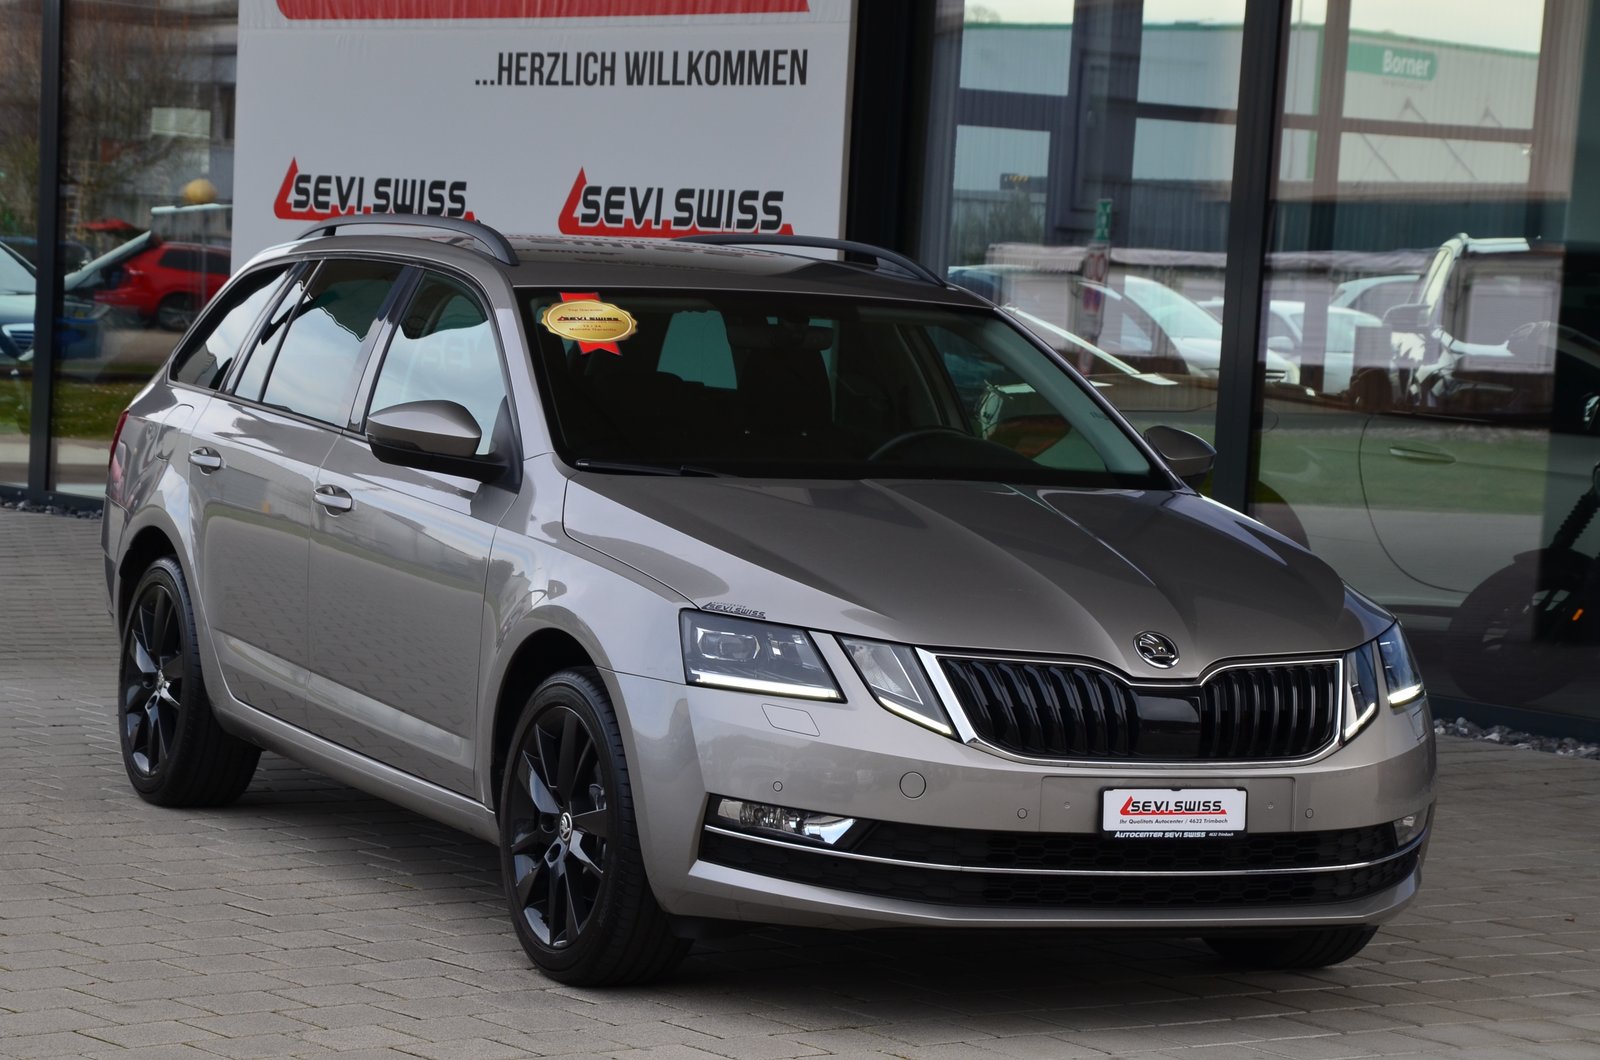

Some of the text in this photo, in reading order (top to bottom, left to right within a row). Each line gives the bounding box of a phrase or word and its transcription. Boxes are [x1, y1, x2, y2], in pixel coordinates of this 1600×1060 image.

[624, 49, 808, 86] WILLKOMMEN
[1382, 49, 1431, 77] Borner
[293, 174, 467, 217] SEVI SWISS
[580, 186, 784, 230] SEVI SWISS
[734, 607, 766, 618] SWISS
[1130, 800, 1222, 812] SEVI SWISS
